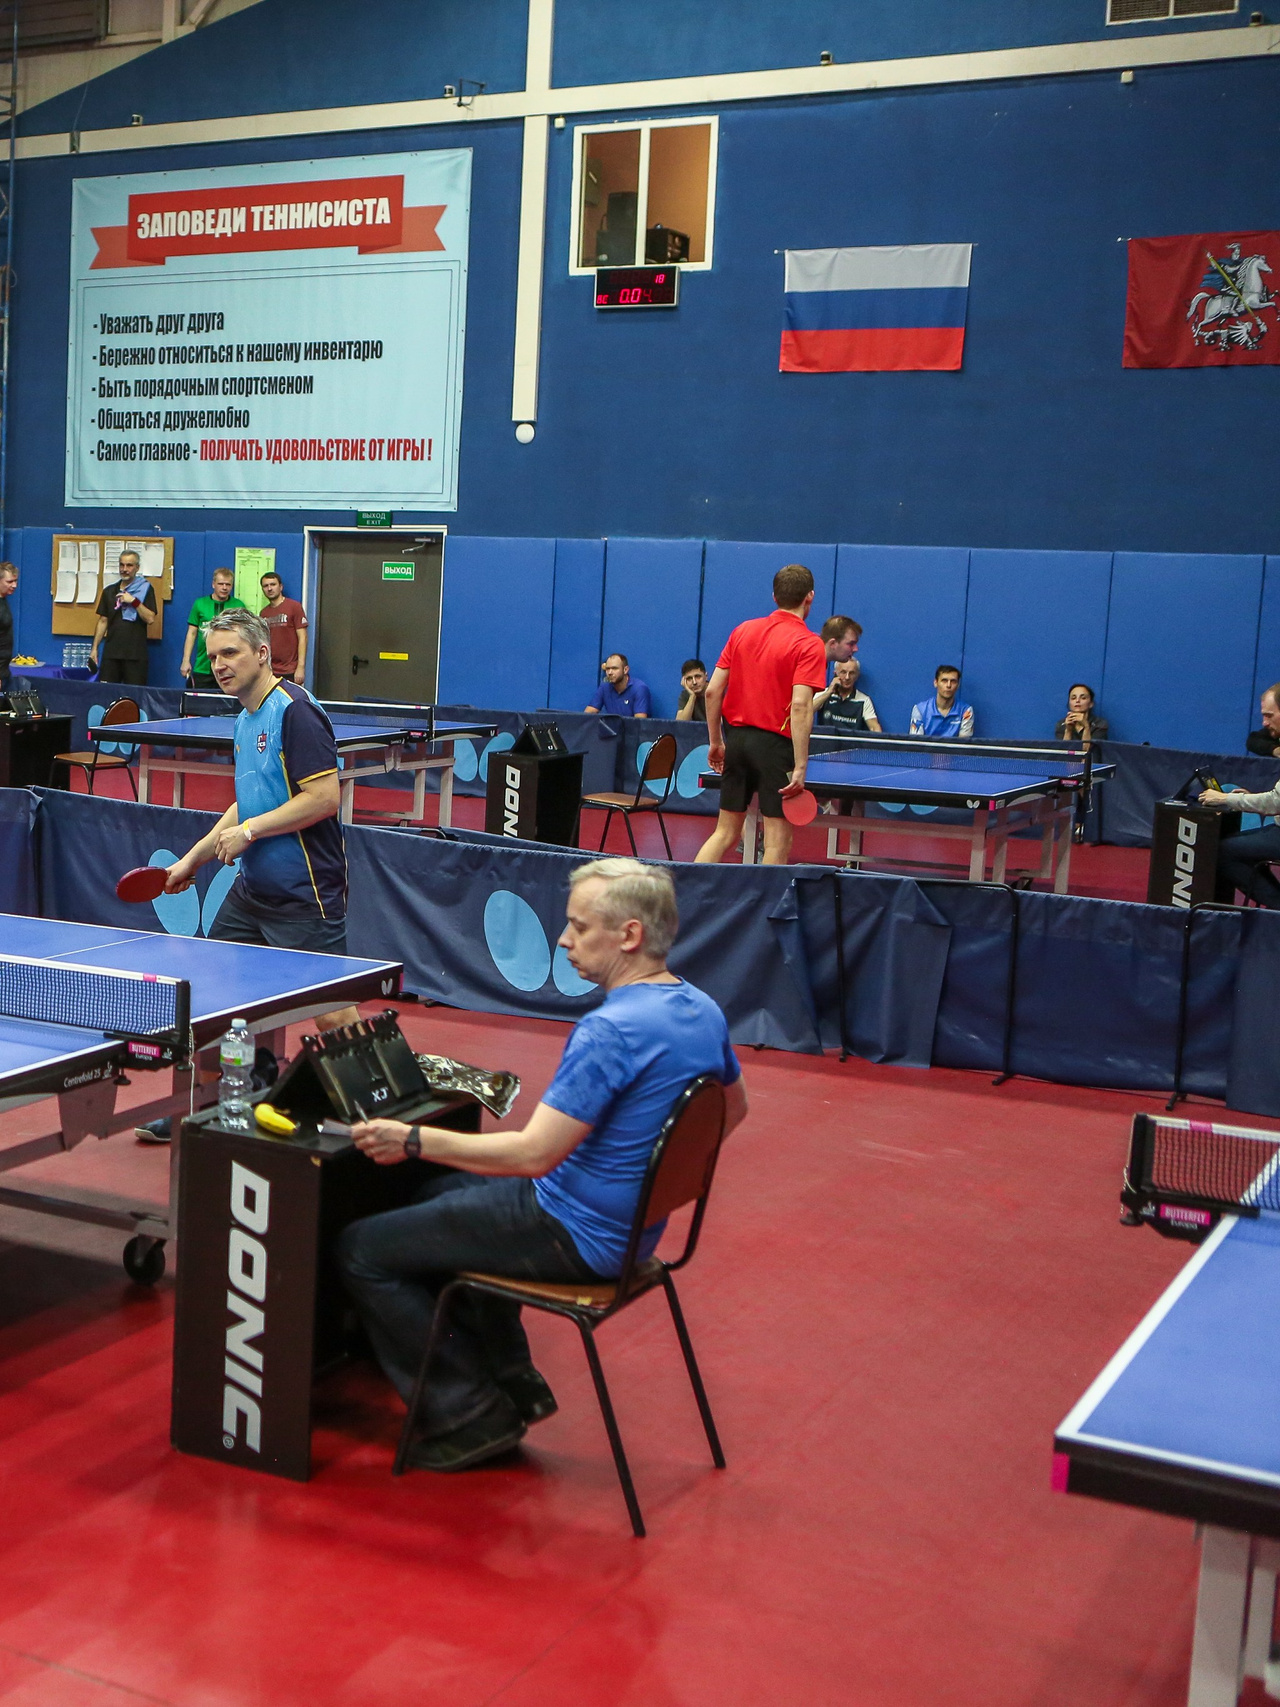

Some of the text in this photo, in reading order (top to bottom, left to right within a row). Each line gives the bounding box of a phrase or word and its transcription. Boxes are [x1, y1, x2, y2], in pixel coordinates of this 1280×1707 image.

[136, 197, 391, 239] ЗАПОВЕДИ ТЕННИСИСТА
[100, 313, 153, 335] Уважать
[155, 313, 186, 336] друг
[187, 311, 224, 335] друга
[99, 345, 156, 368] Бережно
[158, 344, 233, 365] относиться
[236, 343, 244, 362] к
[246, 342, 301, 363] нашему
[303, 339, 384, 362] инвентарю
[98, 376, 131, 398] Быть
[134, 377, 219, 399] порядочным
[221, 375, 314, 398] спортсменом
[97, 408, 161, 432] Общаться
[163, 406, 250, 432] дружелюбно
[97, 439, 136, 461] Самое
[139, 442, 190, 461] главное
[199, 438, 263, 461] ПОЛУЧАТЬ
[266, 438, 366, 464] УДОВОЛЬСТВИЕ
[368, 438, 385, 461] ОТ
[387, 438, 425, 461] ИГРЫ
[361, 512, 386, 520] ВЫХОД
[384, 566, 412, 575] ВЫХОД
[131, 1043, 158, 1056] BUTTERFLY
[1165, 1206, 1206, 1224] BUTTERFLY
[223, 1160, 270, 1453] DONIC
